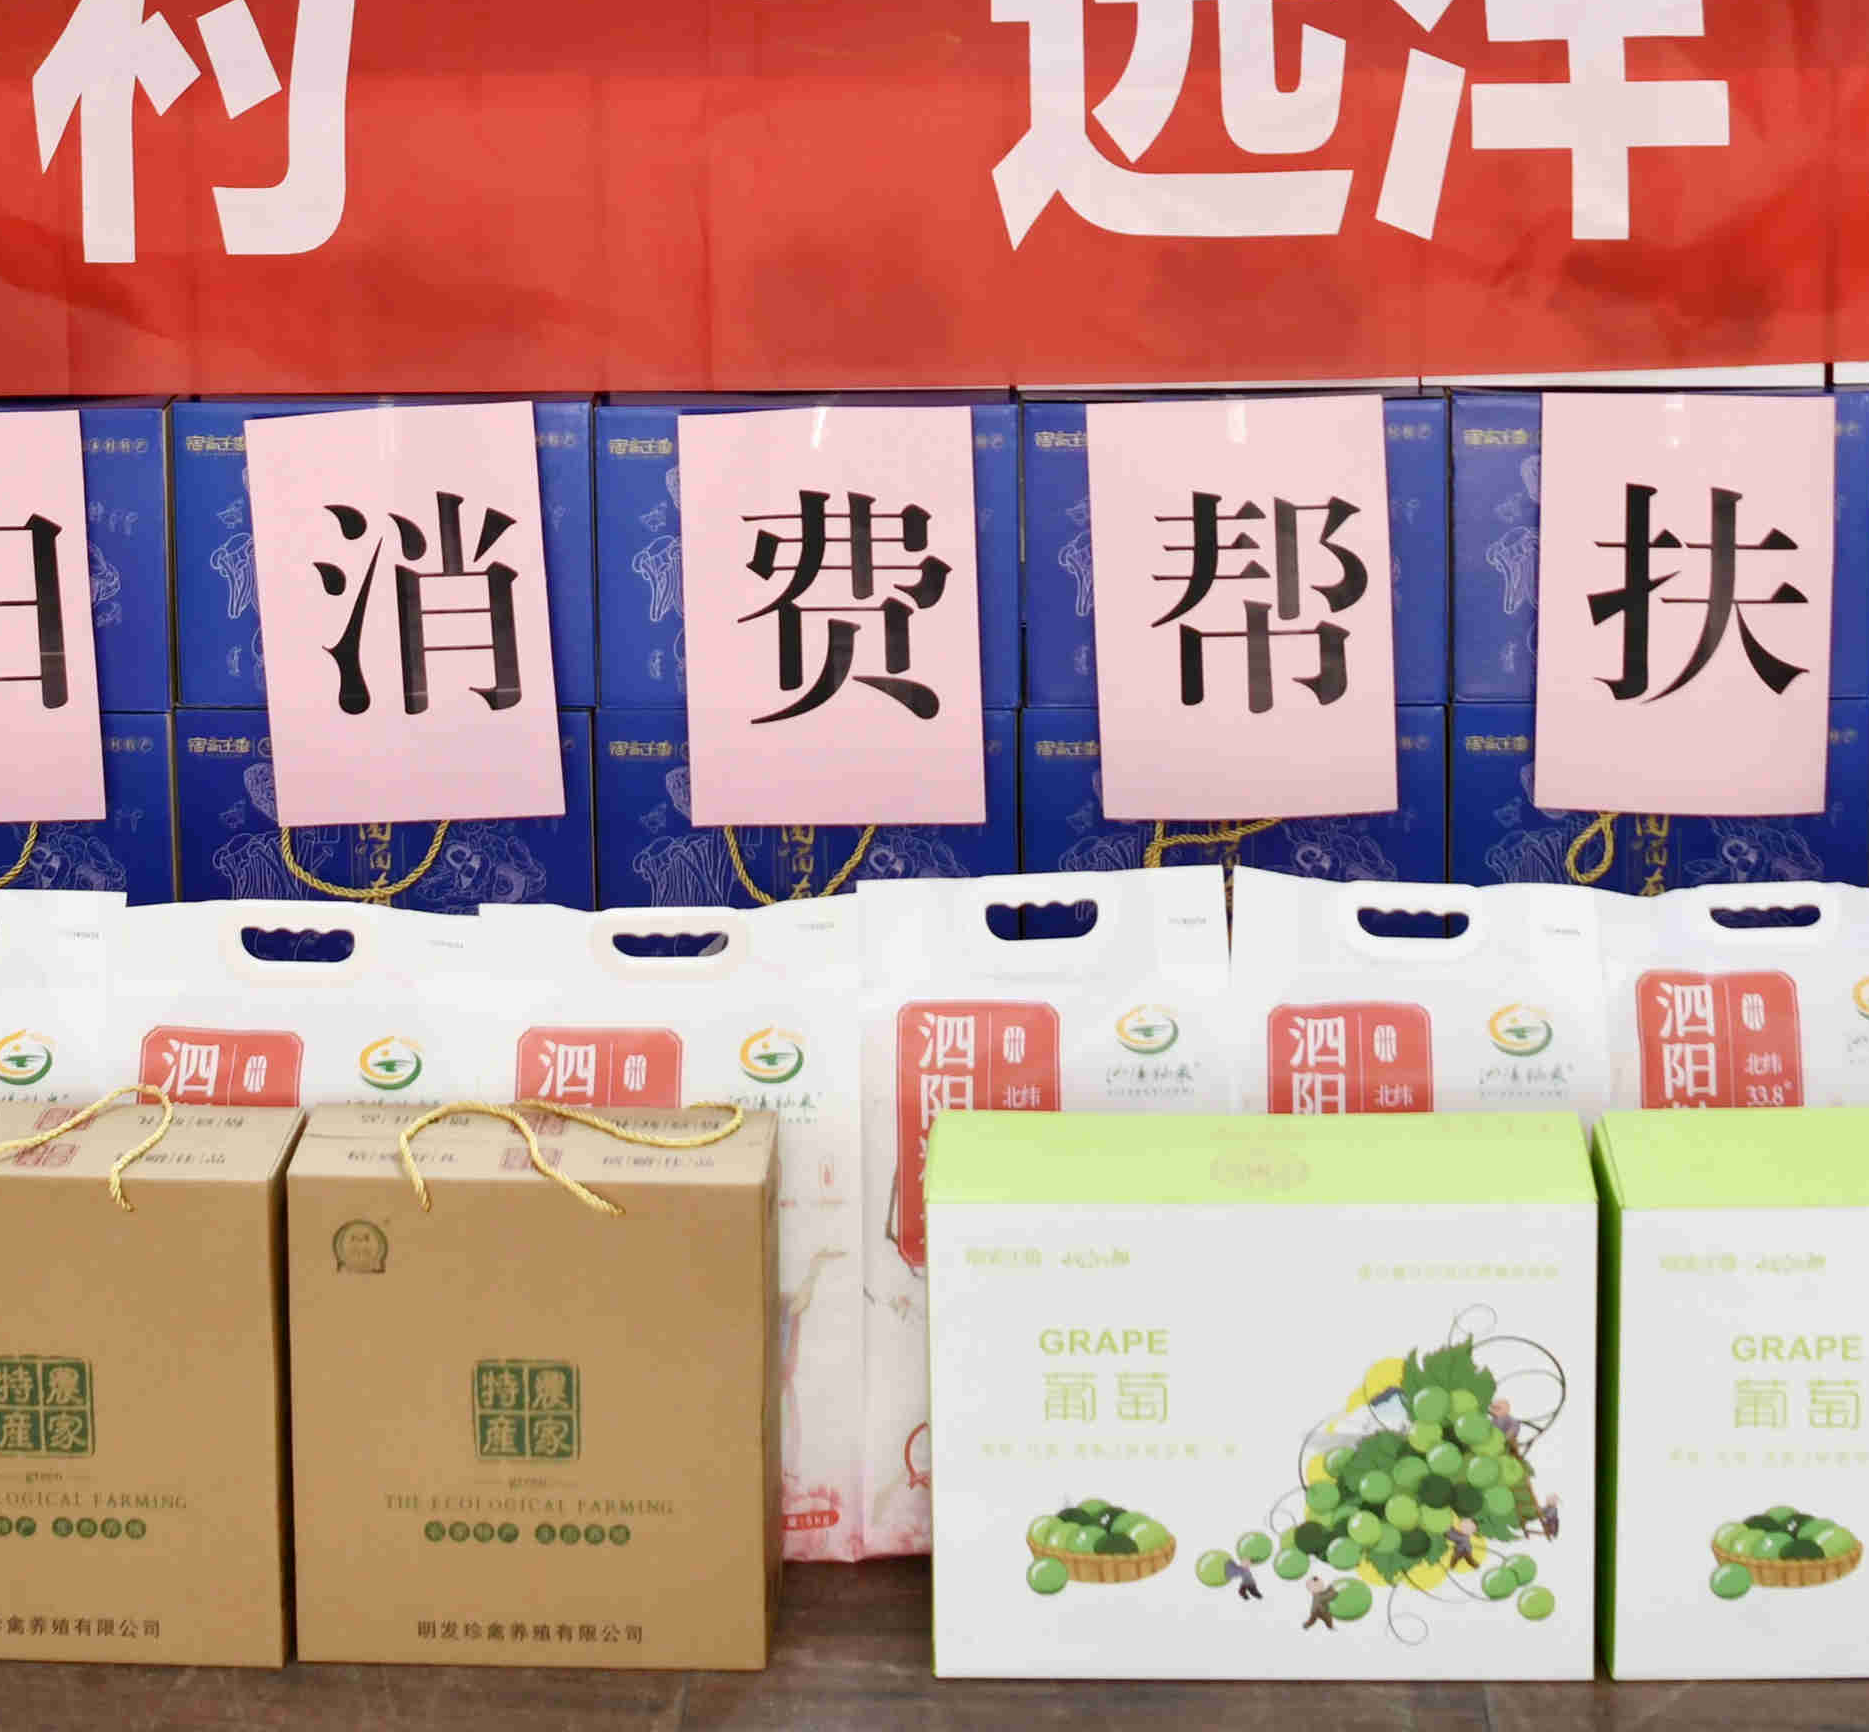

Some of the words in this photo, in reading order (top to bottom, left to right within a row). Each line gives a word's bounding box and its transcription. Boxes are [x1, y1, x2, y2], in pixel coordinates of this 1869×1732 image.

[1656, 982, 1718, 1105] 泗阳
[1289, 1015, 1346, 1115] 泗阳
[1002, 1084, 1042, 1109] 北纬
[1038, 1328, 1170, 1357] GRAPE
[1730, 1335, 1863, 1363] GRAPE
[1042, 1372, 1170, 1424] 葡萄
[1733, 1379, 1863, 1431] 葡萄
[93, 1492, 188, 1510] FARMING
[385, 1494, 421, 1512] THE
[430, 1495, 566, 1515] ECOLOGICAL
[577, 1497, 675, 1517] FARMING
[416, 1619, 644, 1645] 明发珍禽养殖有限公司
